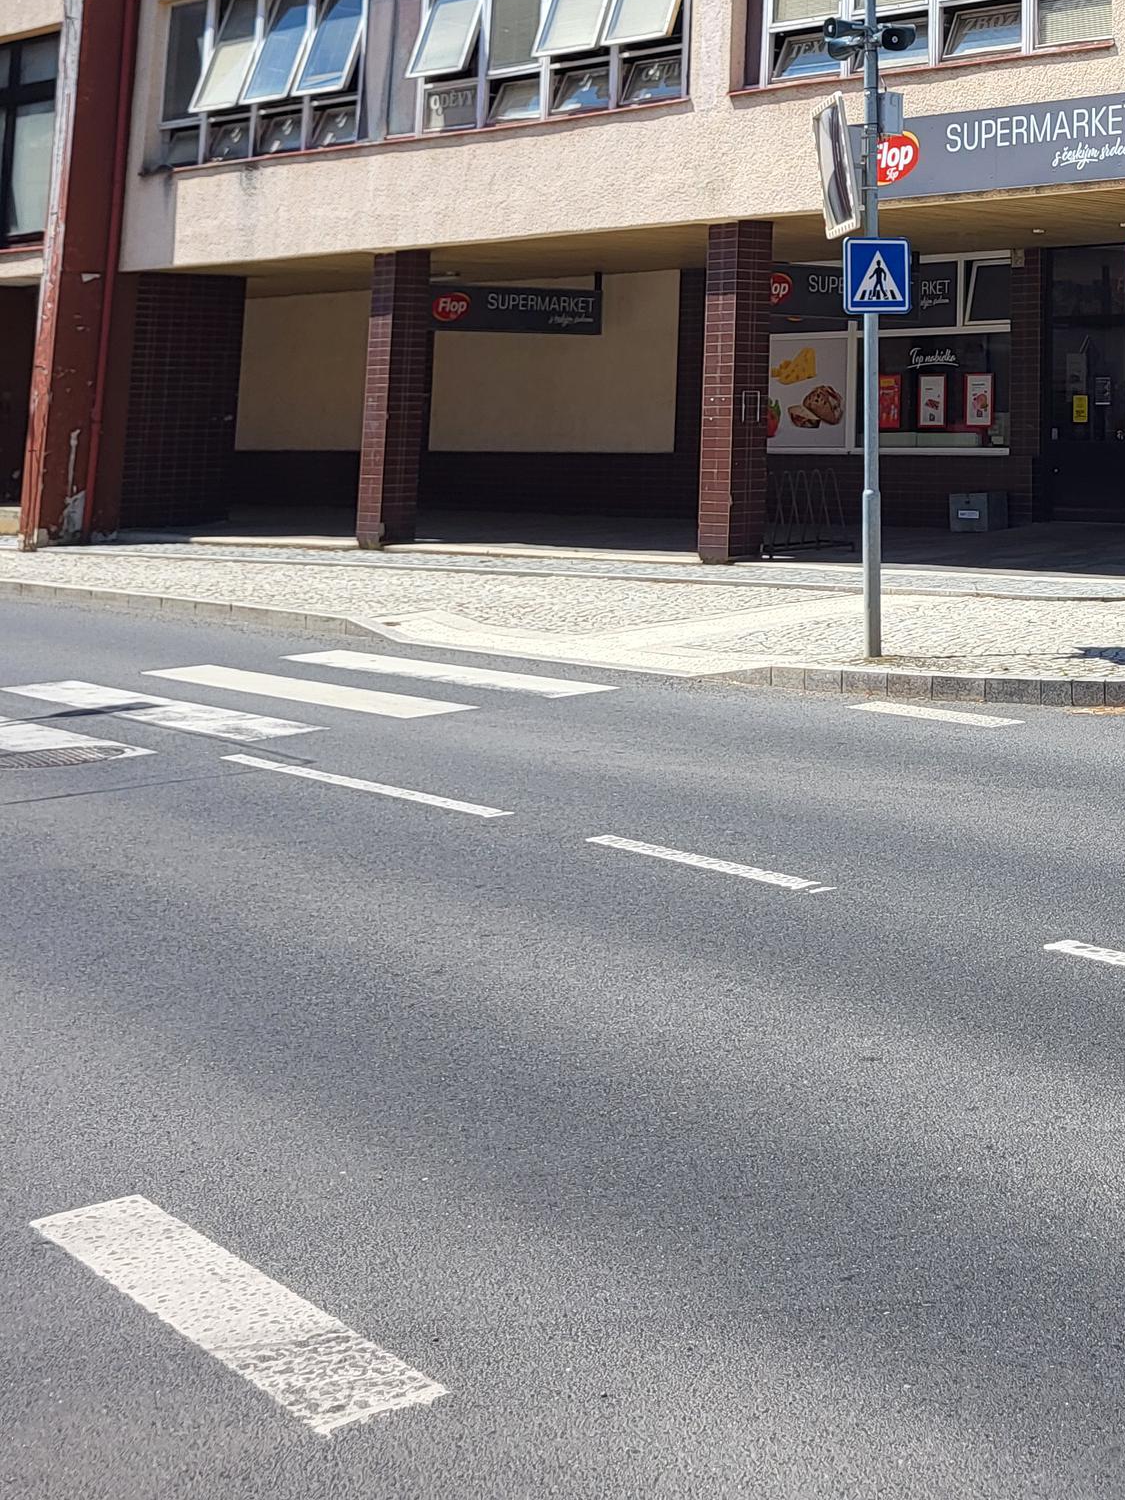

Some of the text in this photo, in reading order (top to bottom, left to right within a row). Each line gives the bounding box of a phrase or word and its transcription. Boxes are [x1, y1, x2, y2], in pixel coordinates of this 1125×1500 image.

[1061, 142, 1099, 170] českým
[438, 298, 467, 314] Flop
[487, 293, 595, 313] SUPERMARKET
[910, 347, 923, 369] Top
